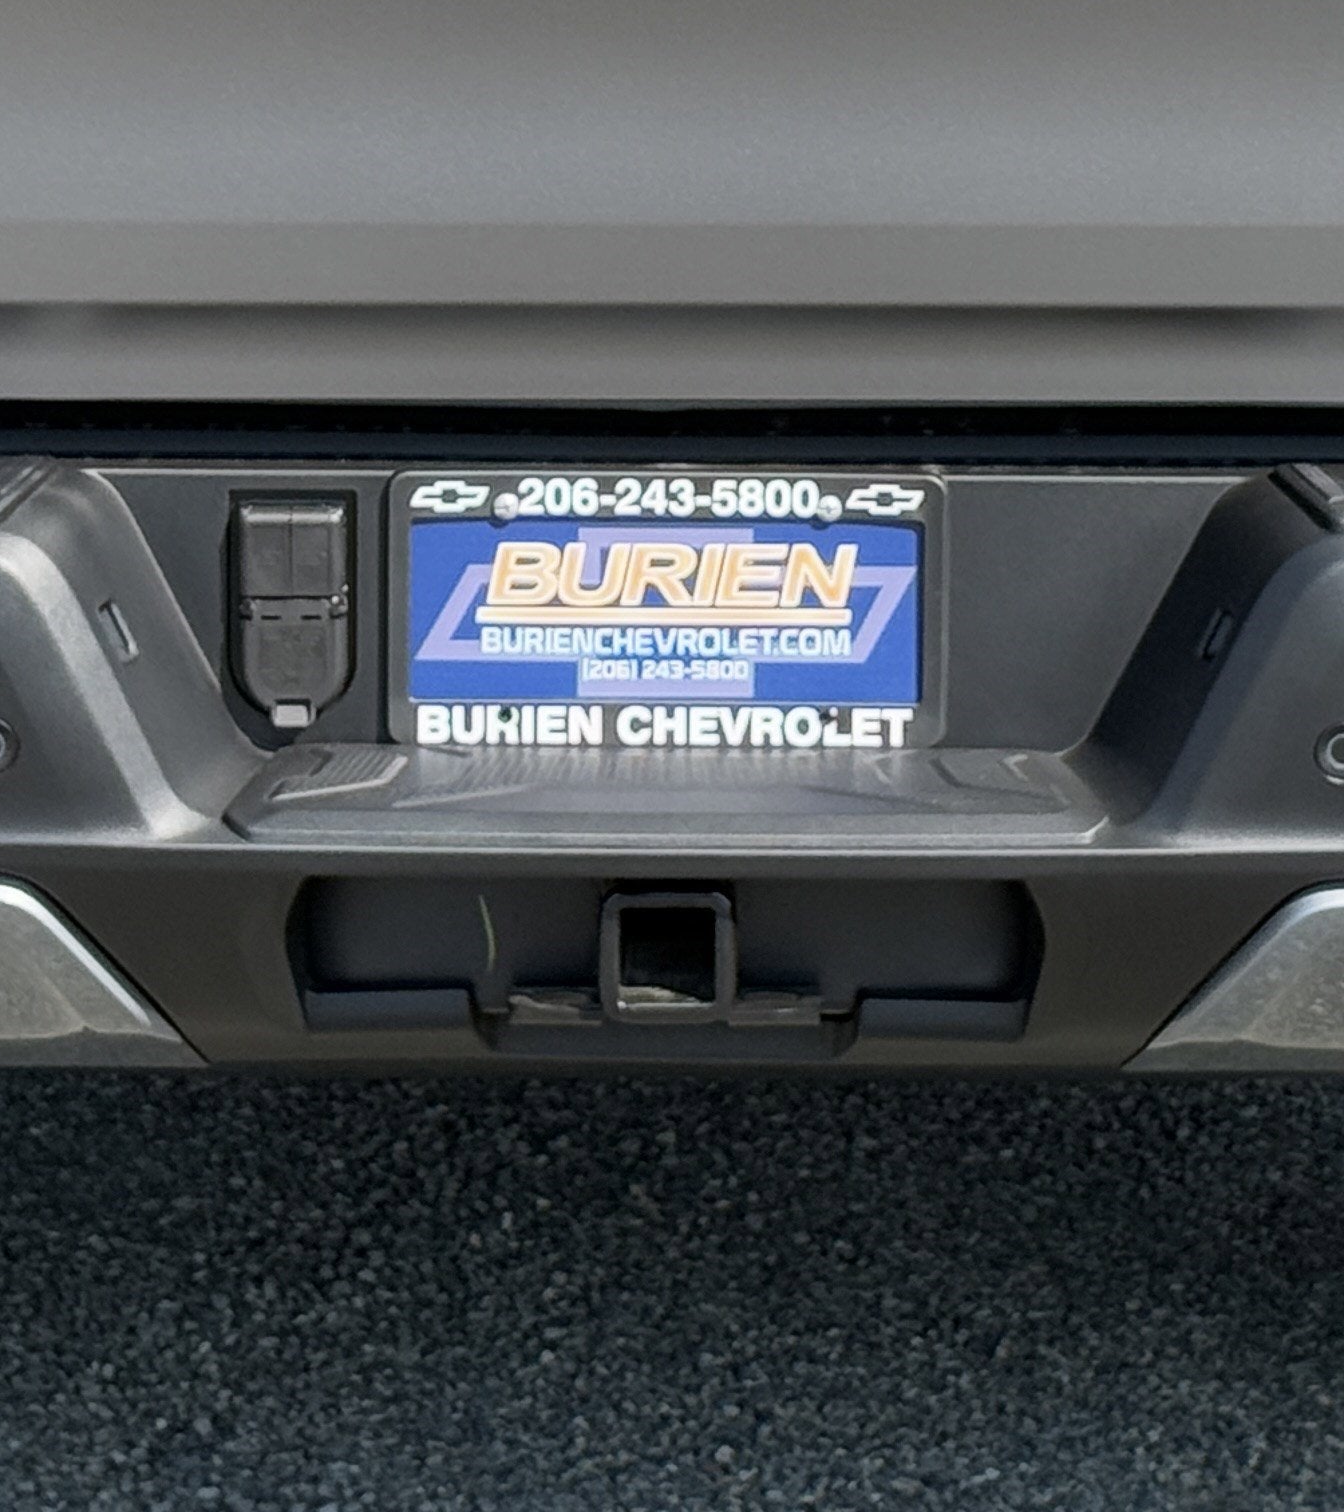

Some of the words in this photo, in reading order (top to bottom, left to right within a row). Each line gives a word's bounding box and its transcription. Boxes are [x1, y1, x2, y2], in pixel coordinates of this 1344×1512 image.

[517, 477, 820, 518] 206-243-5800
[486, 541, 859, 608] BURIEN
[480, 626, 852, 657] BURIENCHEVROLET.COM
[581, 658, 638, 681] (206)
[641, 659, 749, 681] 243-5800
[416, 704, 604, 747] BURIEN
[616, 704, 914, 748] CHEVROLET
